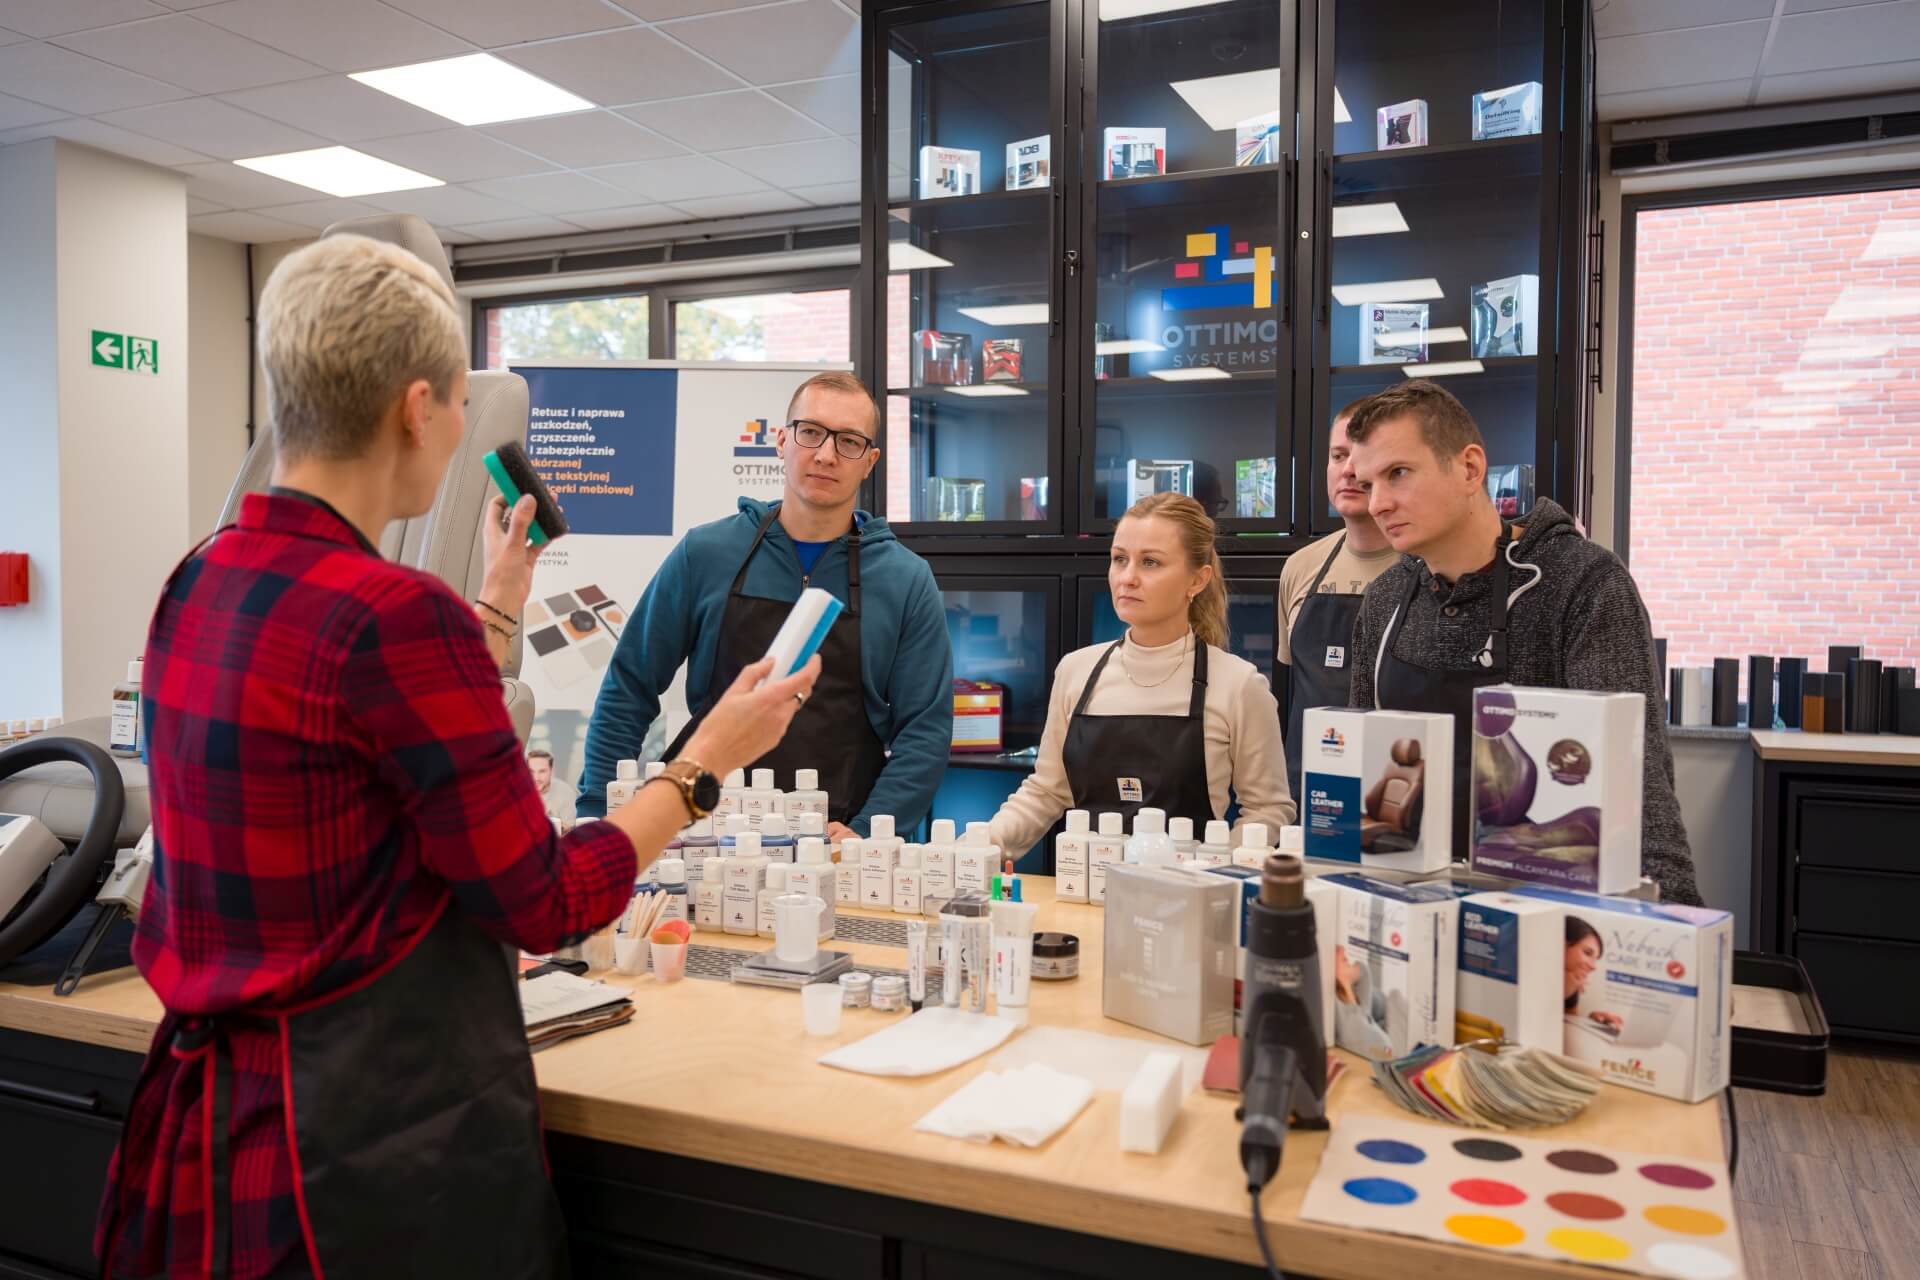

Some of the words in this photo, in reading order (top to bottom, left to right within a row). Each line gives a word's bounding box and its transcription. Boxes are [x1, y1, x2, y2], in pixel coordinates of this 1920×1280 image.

[1162, 319, 1277, 348] OTTIMO
[1173, 350, 1270, 368] SYSTEMS
[531, 407, 569, 417] Retusz
[571, 407, 576, 417] i
[578, 409, 625, 419] naprawa
[531, 420, 592, 430] uszkodzeń,
[530, 433, 596, 443] czyszczenie
[536, 445, 616, 456] zabezpiecznie
[556, 471, 610, 482] tekstylnej
[579, 485, 634, 496] meblowej
[1476, 856, 1513, 869] PREMIUM
[1514, 862, 1567, 879] ALCANTARA
